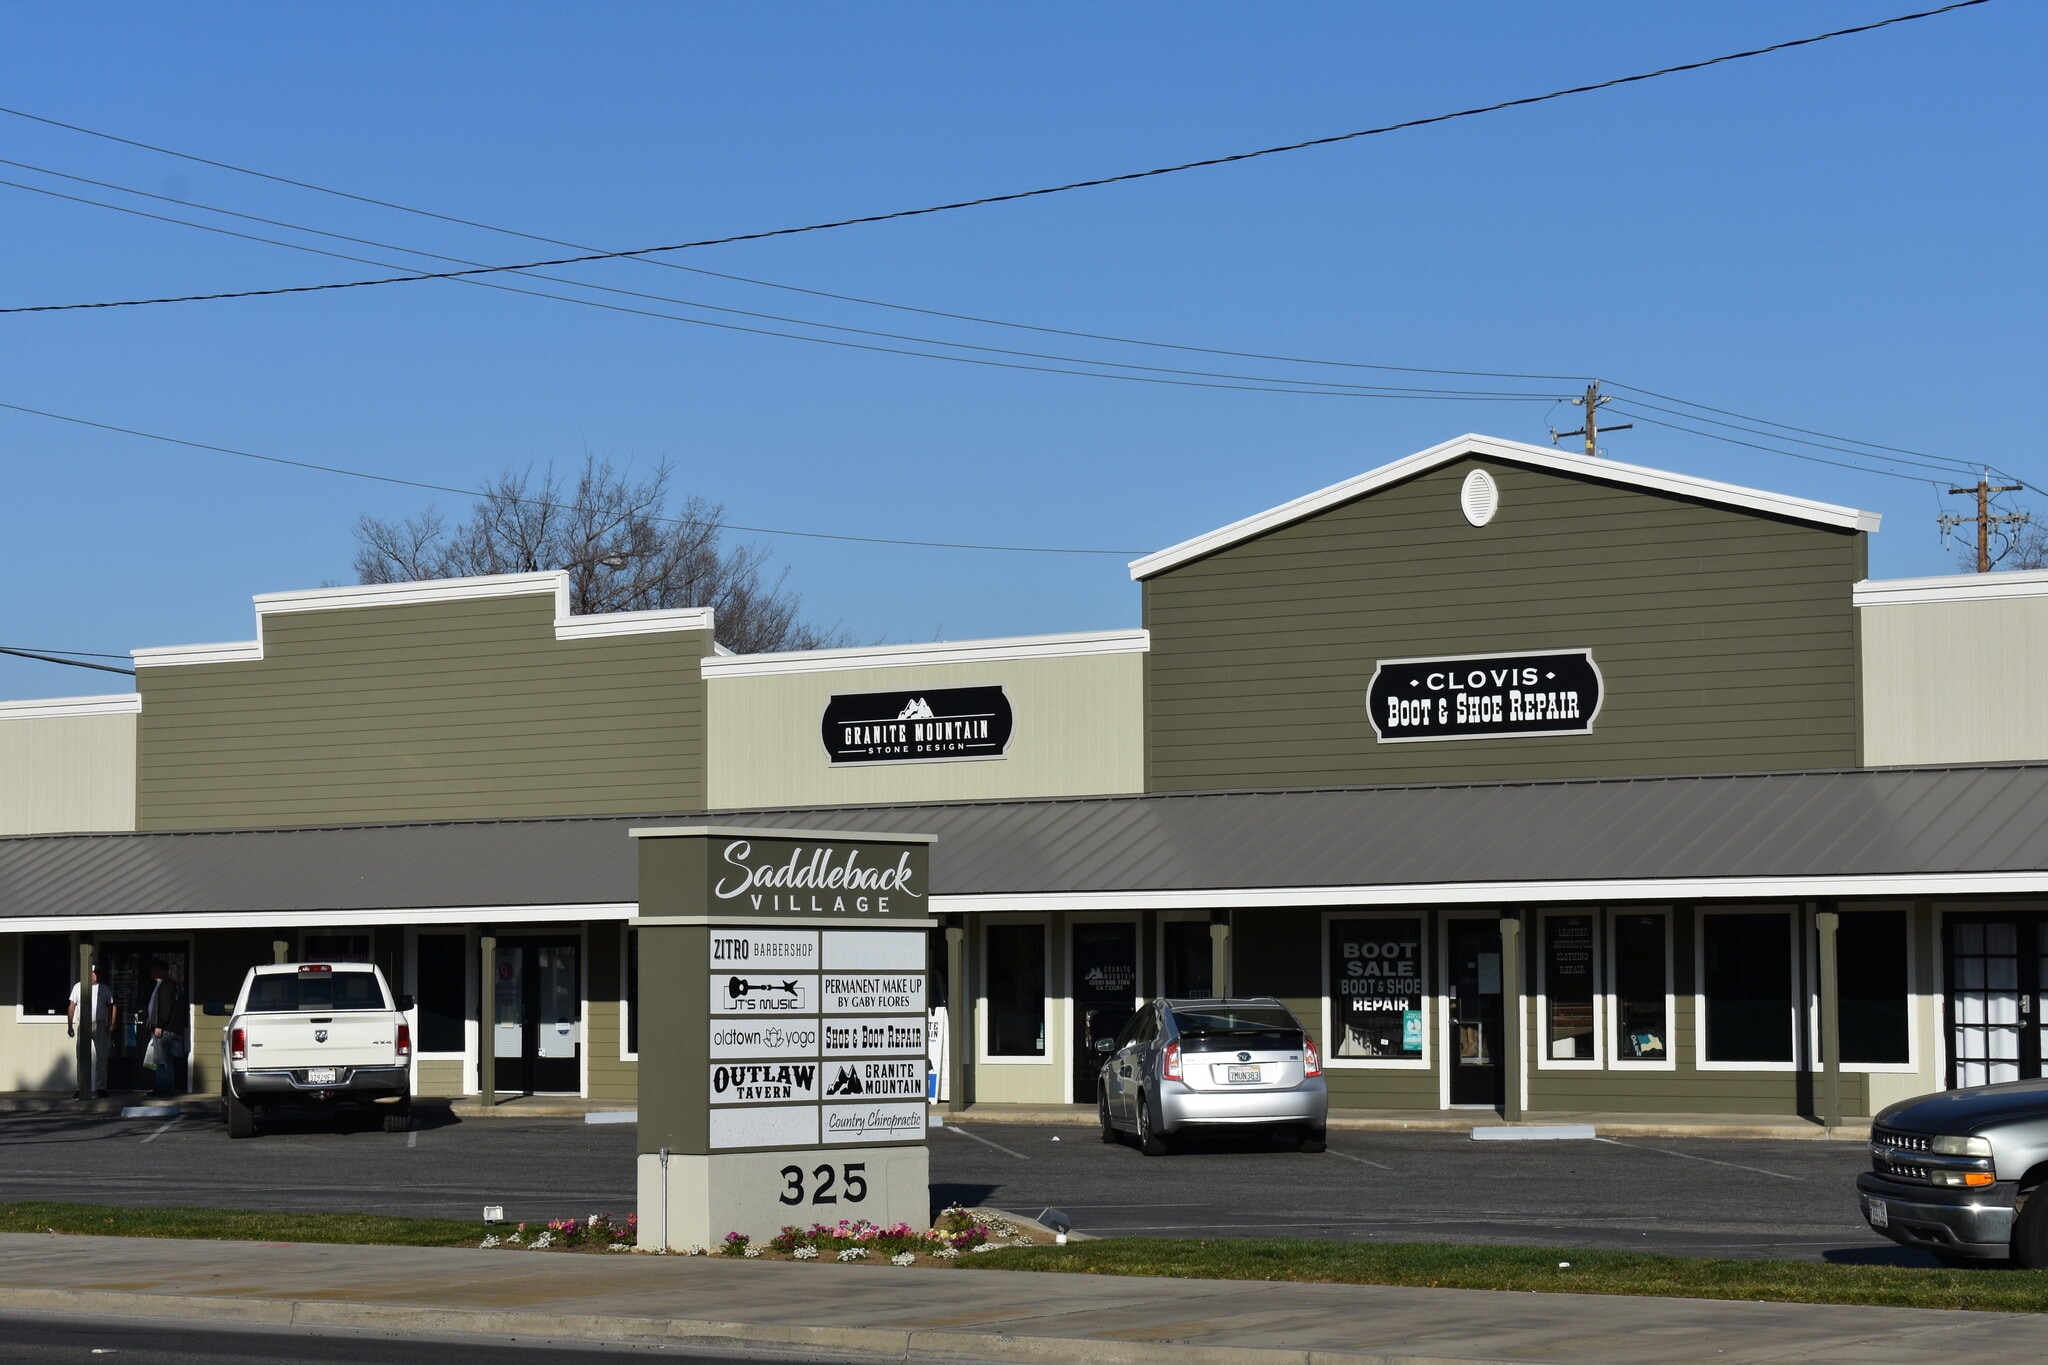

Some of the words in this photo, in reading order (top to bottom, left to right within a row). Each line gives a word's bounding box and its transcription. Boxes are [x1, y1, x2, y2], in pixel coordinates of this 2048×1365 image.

[1426, 667, 1538, 691] CLOVIS
[1387, 696, 1431, 728] BOOT
[1438, 697, 1449, 724] &
[1456, 692, 1503, 724] SHOE
[1509, 689, 1580, 722] REPAIR
[845, 724, 906, 745] GRANITE
[915, 719, 988, 742] MOUNTAIN
[868, 746, 909, 755] STONE
[917, 743, 964, 752] DESIGN
[715, 840, 922, 899] Saddleback
[751, 894, 889, 912] VILLAGE
[714, 939, 749, 960] ZITRO
[754, 943, 813, 957] BARBERSHOP
[1343, 942, 1418, 959] BOOT
[1556, 952, 1589, 961] CLOTHING
[1347, 960, 1414, 977] SALE
[1559, 965, 1586, 975] REPAIR
[825, 979, 879, 994] PERMANENT
[882, 979, 907, 993] MAKE
[910, 979, 922, 993] UP
[1341, 979, 1376, 995] BOOT
[1377, 980, 1384, 993] &
[1386, 978, 1421, 994] SHOE
[729, 999, 756, 1010] JT'S
[759, 999, 798, 1010] MUSIC
[838, 997, 849, 1008] BY
[851, 997, 876, 1008] GABY
[878, 996, 910, 1007] FLORES
[1352, 996, 1409, 1011] REPAIR
[714, 1029, 761, 1046] oldtown
[786, 1030, 815, 1047] yoga
[826, 1026, 850, 1049] SHOE
[852, 1028, 858, 1048] &
[862, 1025, 884, 1048] BOOT
[887, 1025, 922, 1048] REPAIR
[713, 1065, 815, 1093] OUTLAW
[865, 1064, 914, 1078] GRANITE
[1230, 1071, 1259, 1080] 7MUN383
[737, 1086, 791, 1099] TAVERN
[865, 1079, 921, 1094] MOUNTAIN
[829, 1113, 865, 1135] Country
[868, 1109, 921, 1134] Chiropractic
[779, 1161, 868, 1206] 325
